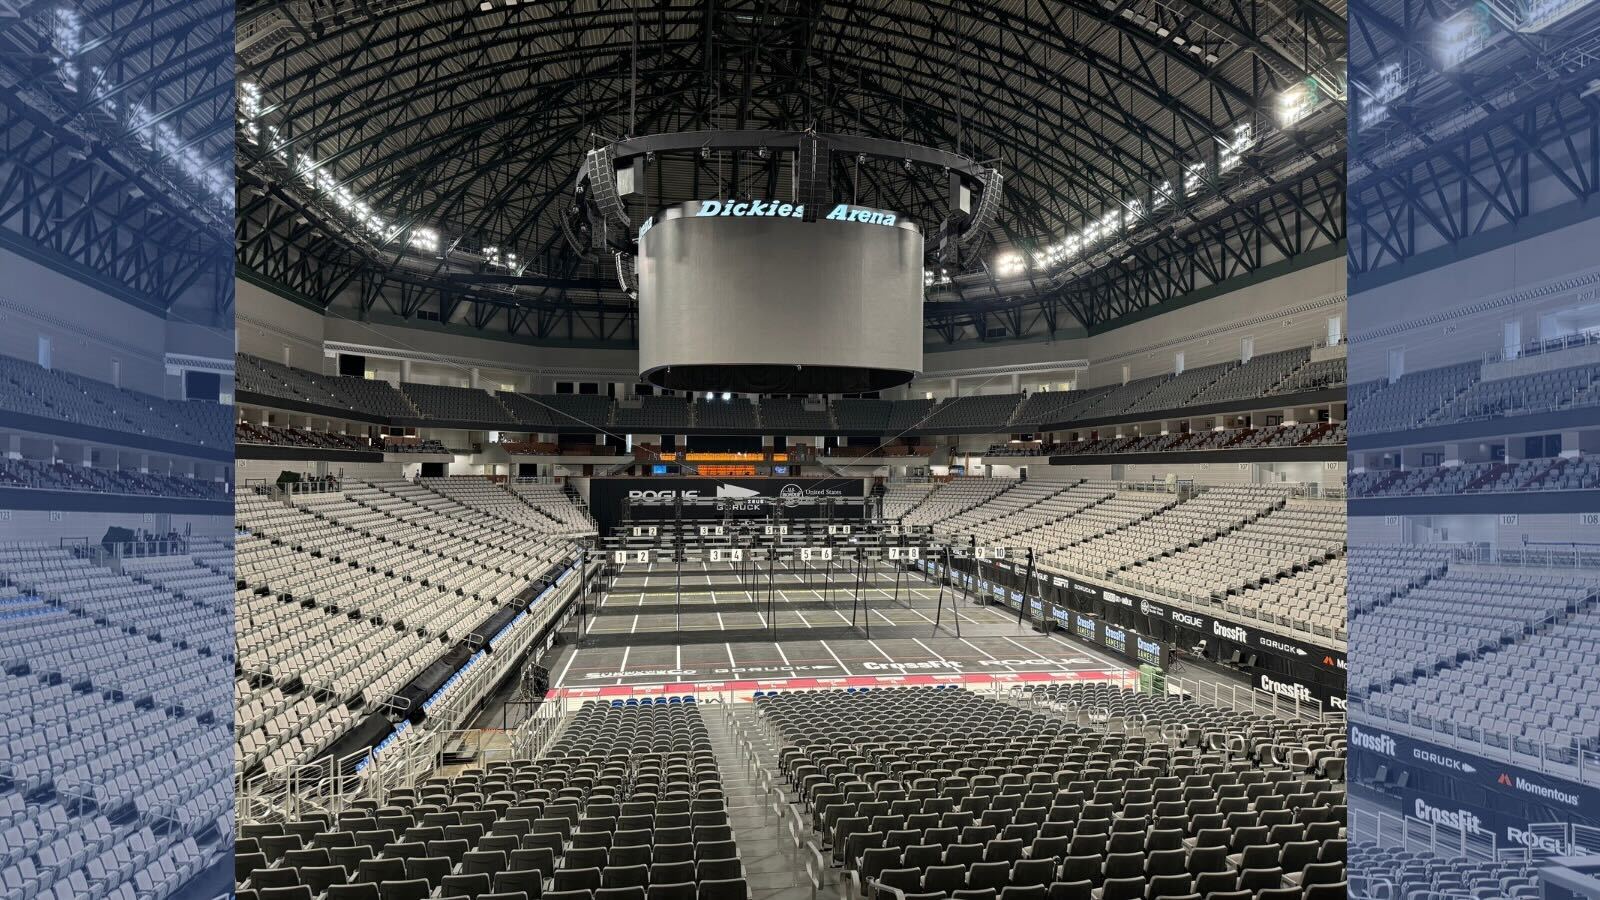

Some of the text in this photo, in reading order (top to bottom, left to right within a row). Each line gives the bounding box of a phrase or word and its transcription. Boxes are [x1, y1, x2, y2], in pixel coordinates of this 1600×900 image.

[696, 199, 896, 226] Dickies Arena
[1386, 516, 1398, 525] 107
[1503, 516, 1516, 525] 107
[1583, 514, 1599, 524] 108
[1053, 577, 1068, 588] ESPN
[1077, 615, 1095, 631] CrossFit
[1172, 611, 1203, 628] ROGUE
[1105, 625, 1126, 642] CrossFit
[1213, 621, 1247, 643] CrossFit
[1137, 636, 1160, 656] CrossFit
[1259, 637, 1296, 654] GORUCK
[863, 660, 964, 671] CrossFit
[977, 657, 1093, 667] ROGUE
[1261, 674, 1310, 702] CrossFit
[1351, 726, 1396, 757] CrossFit
[1413, 748, 1461, 771] GORUCK
[1516, 777, 1579, 805] Momentous
[1415, 798, 1481, 834] CrossFit
